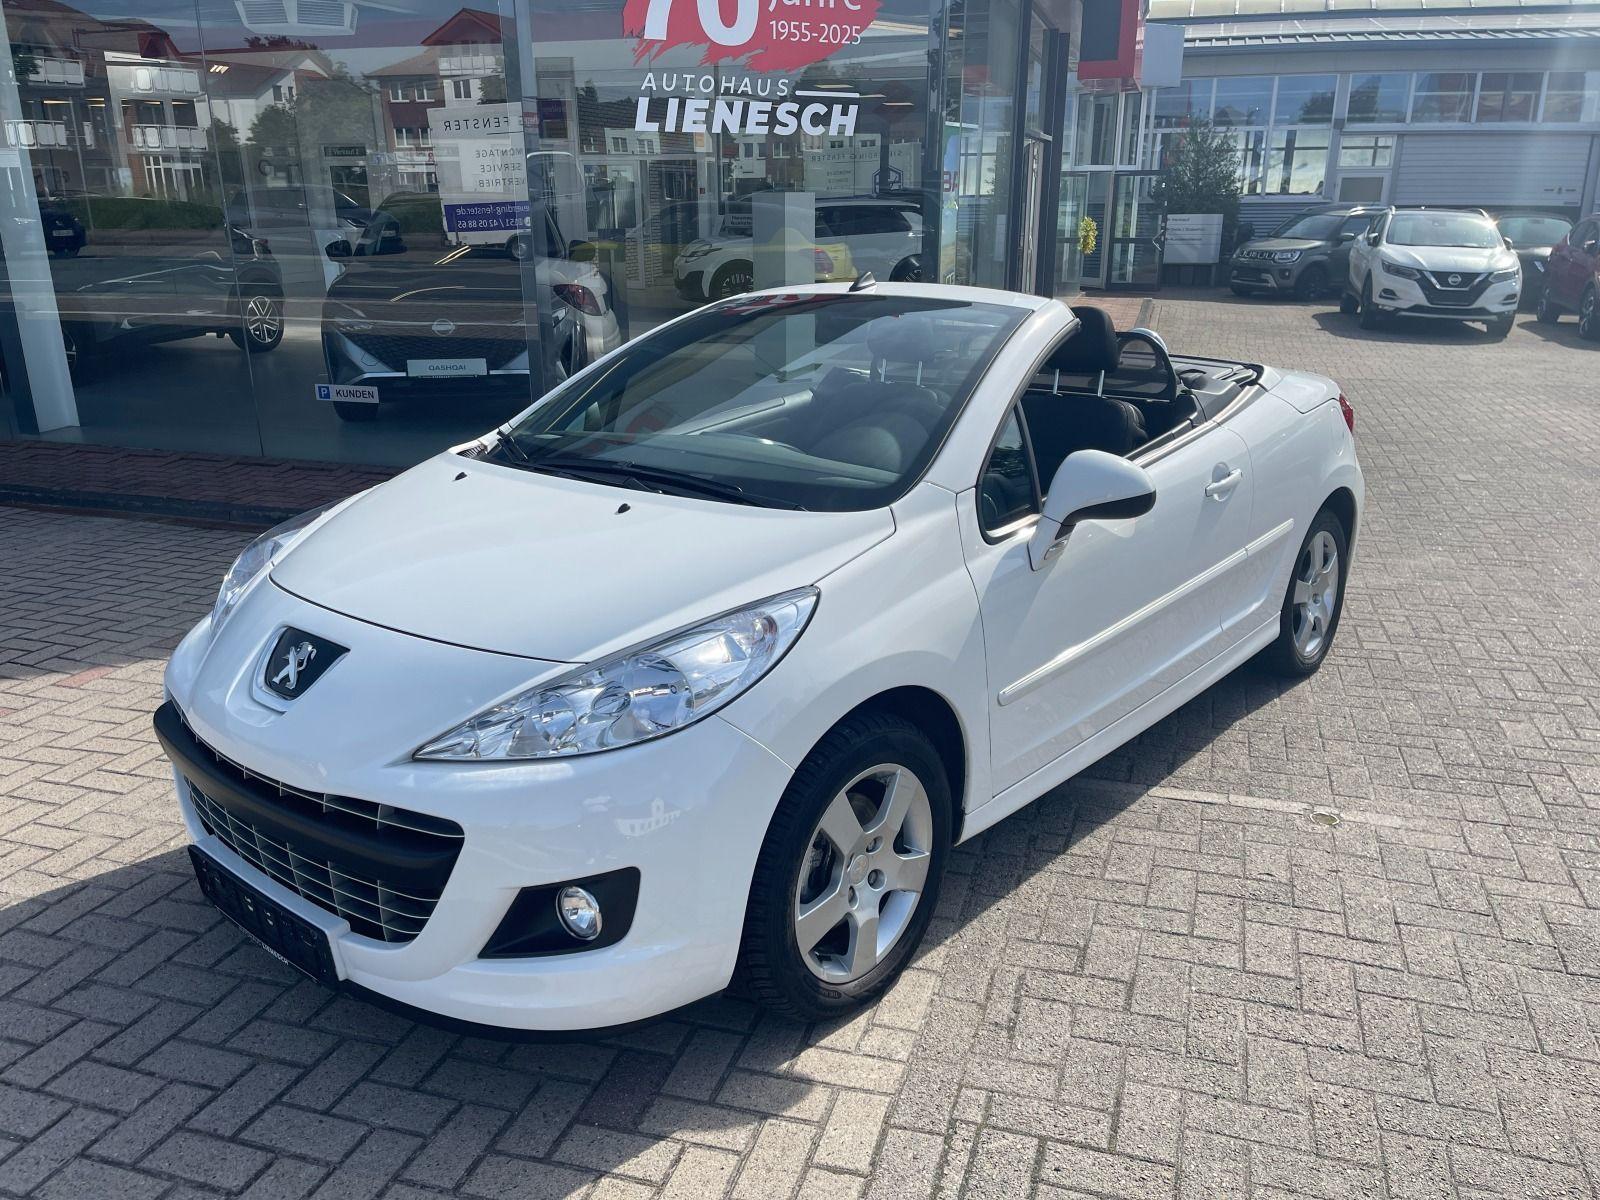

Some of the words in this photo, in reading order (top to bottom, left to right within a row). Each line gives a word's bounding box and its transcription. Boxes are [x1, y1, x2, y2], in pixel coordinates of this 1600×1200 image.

[769, 20, 861, 45] 1955-2025
[640, 72, 789, 97] AUTOHAUS
[634, 96, 859, 137] LIENESCH
[335, 388, 375, 399] KUNDEN
